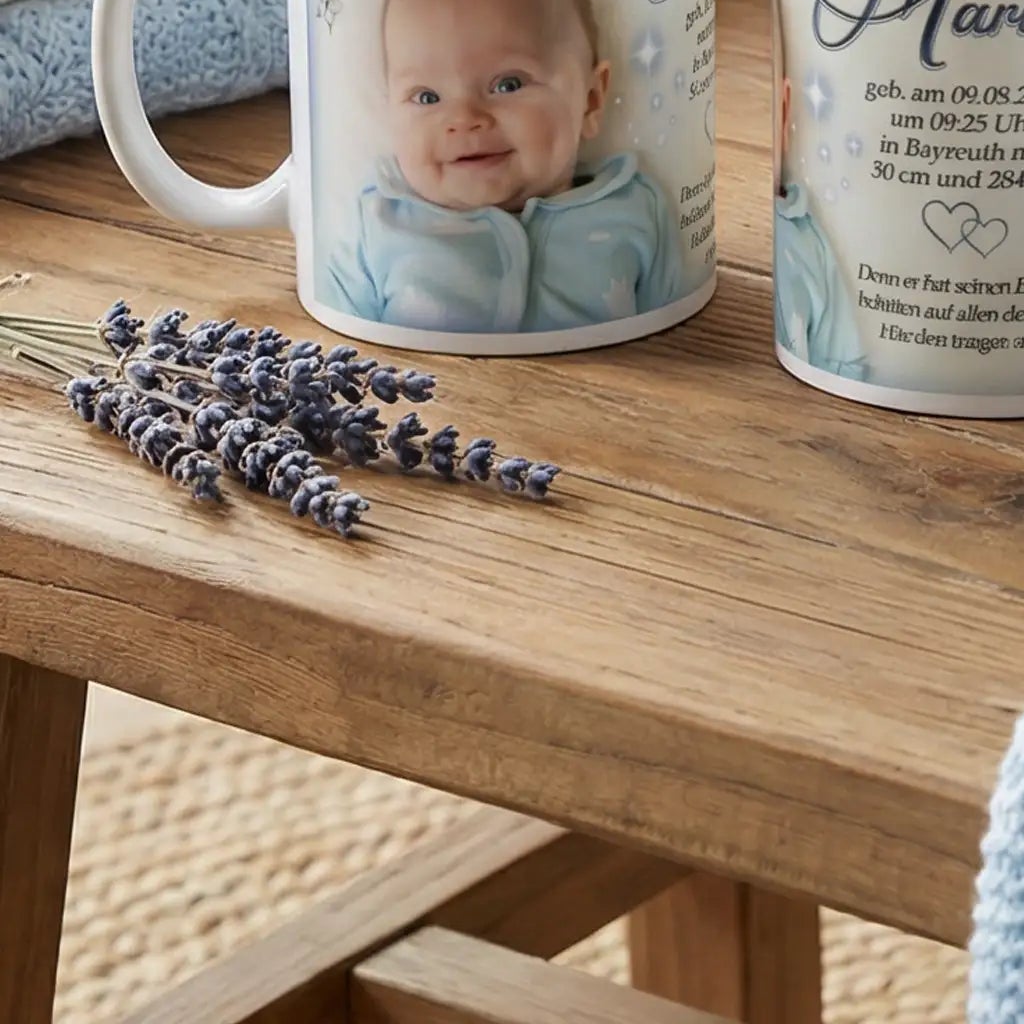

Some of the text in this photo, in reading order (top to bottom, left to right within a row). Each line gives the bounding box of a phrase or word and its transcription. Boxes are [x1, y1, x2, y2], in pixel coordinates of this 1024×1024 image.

[864, 79, 905, 102] geb.
[910, 86, 945, 104] am
[890, 112, 924, 130] um
[879, 134, 899, 155] in
[904, 137, 1005, 166] Bayreuth
[870, 160, 895, 181] 30
[898, 170, 930, 186] cm
[937, 170, 982, 189] und
